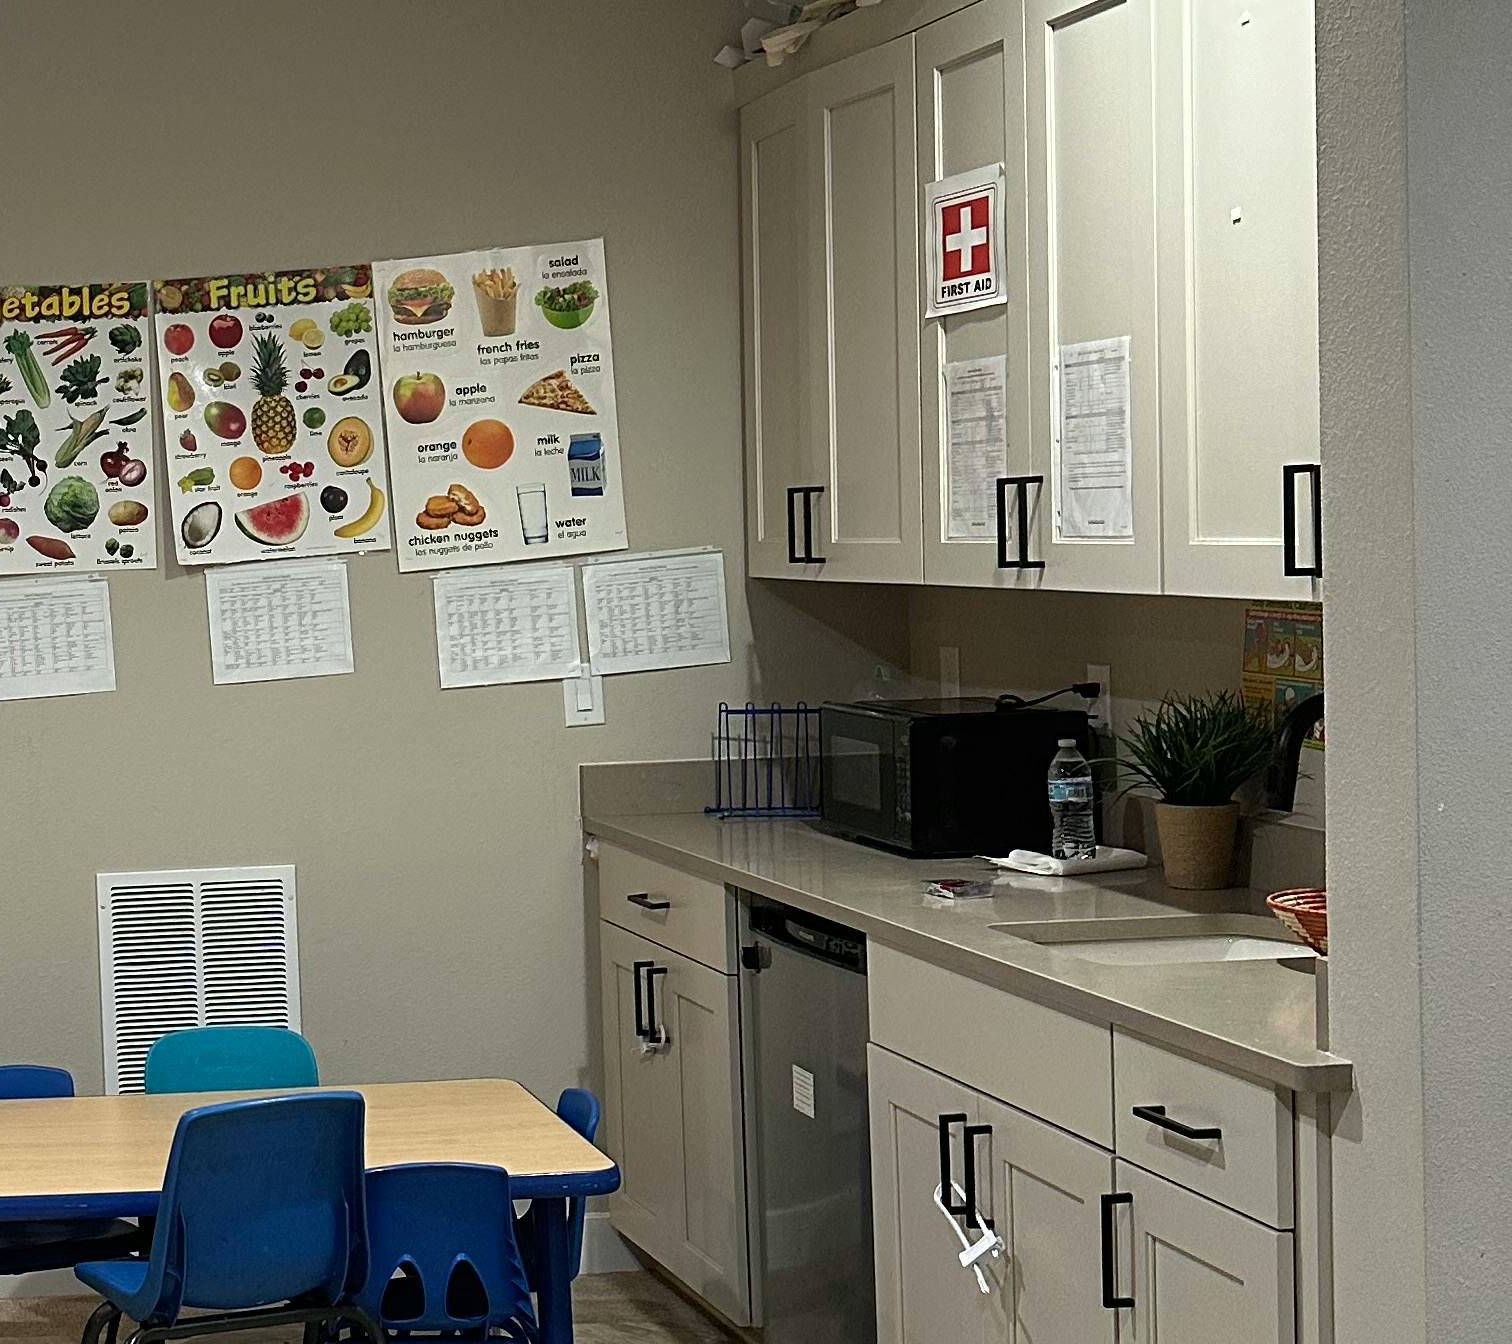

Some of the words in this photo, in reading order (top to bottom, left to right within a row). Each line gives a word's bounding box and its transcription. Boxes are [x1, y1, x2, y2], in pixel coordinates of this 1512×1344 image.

[549, 255, 579, 268] salad
[552, 268, 588, 279] ensalada
[210, 273, 317, 308] Fruits
[941, 282, 971, 298] FIRST
[974, 278, 991, 292] AID
[393, 327, 455, 342] hamburger
[403, 339, 457, 351] hamburguesa
[477, 341, 512, 355] french
[515, 340, 540, 351] fries
[570, 353, 600, 366] pizza
[455, 383, 487, 396] apple
[417, 441, 457, 453] orange
[537, 434, 560, 447] milk
[428, 452, 458, 463] naranja
[571, 466, 601, 482] MILK
[555, 517, 587, 528] water
[408, 534, 450, 546] chicken
[454, 528, 499, 542] nuggets
